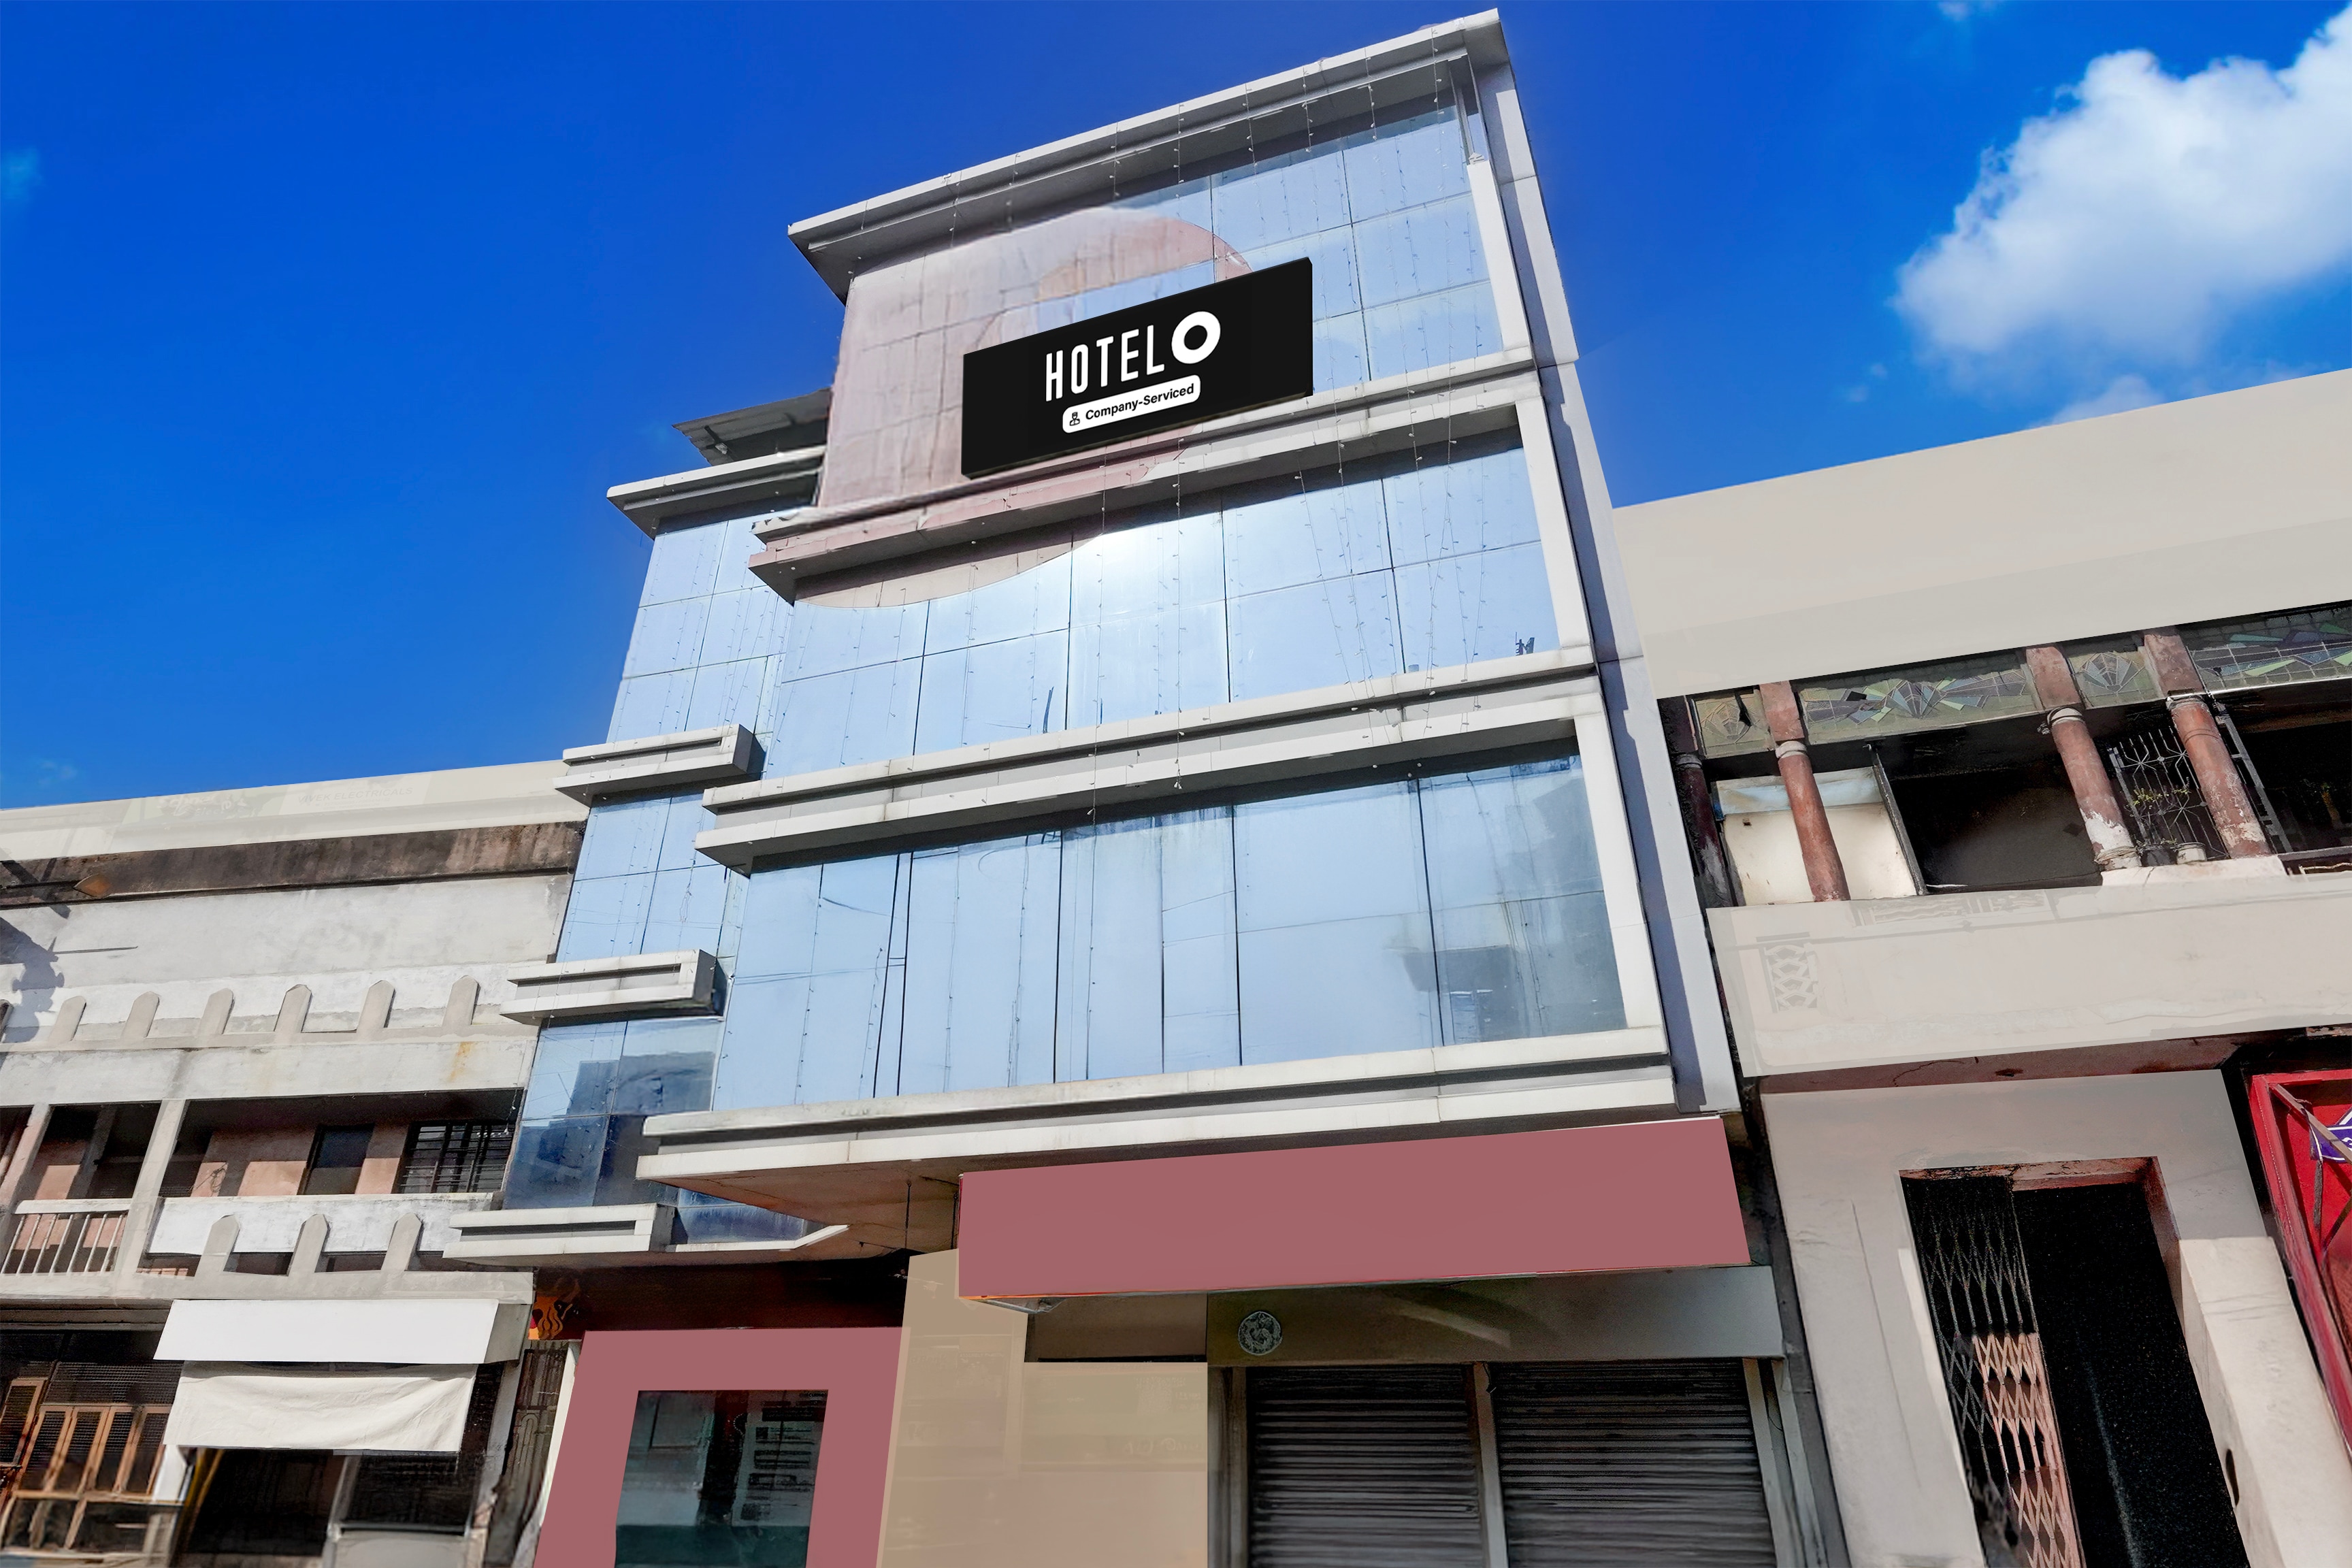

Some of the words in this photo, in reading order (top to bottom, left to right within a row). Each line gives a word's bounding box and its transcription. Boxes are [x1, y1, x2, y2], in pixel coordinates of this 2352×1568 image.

[1045, 325, 1165, 402] HOTEL
[1085, 382, 1195, 421] Company-Serviced
[334, 787, 413, 800] ELECTRICALS
